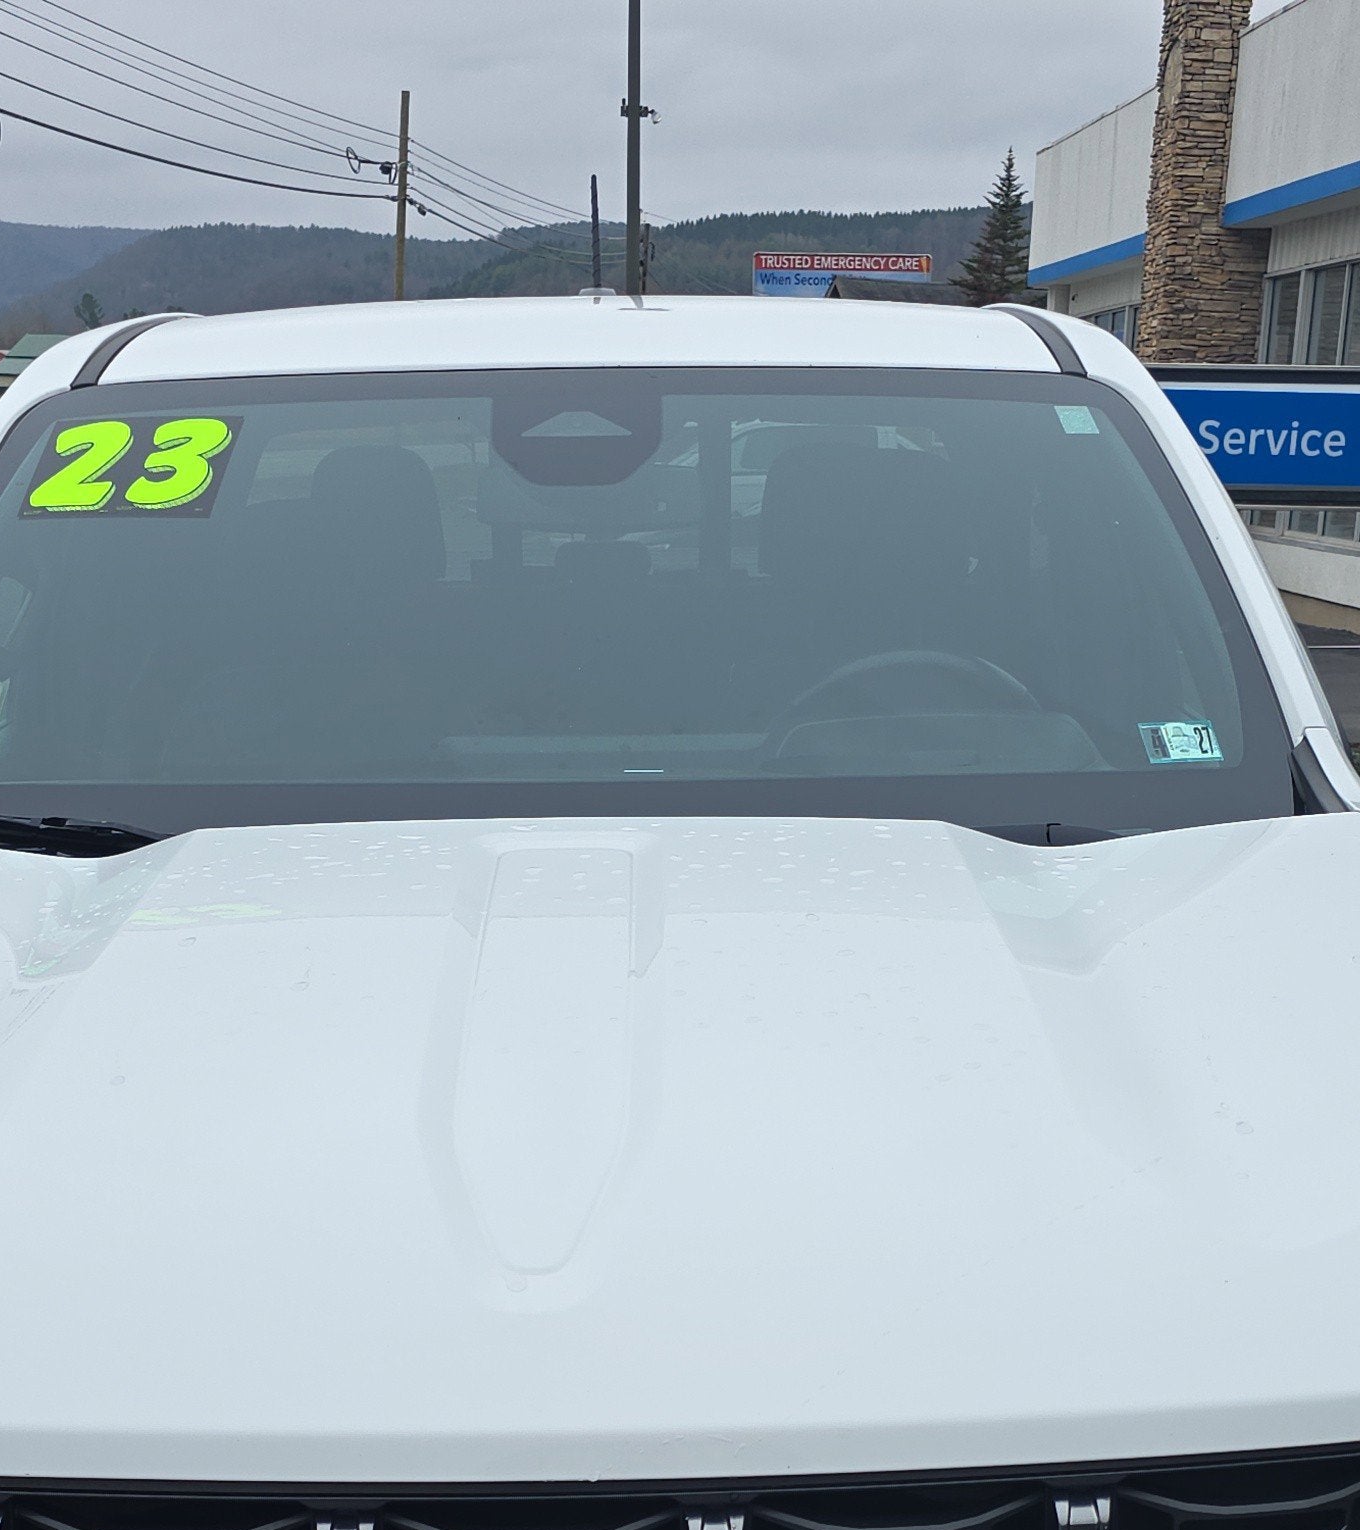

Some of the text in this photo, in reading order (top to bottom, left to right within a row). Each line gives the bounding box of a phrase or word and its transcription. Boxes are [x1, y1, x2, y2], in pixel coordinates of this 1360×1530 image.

[760, 255, 920, 270] TRUSTED EMERGENCY CARE
[760, 272, 791, 286] When
[1198, 419, 1346, 458] Service
[29, 417, 232, 512] 23
